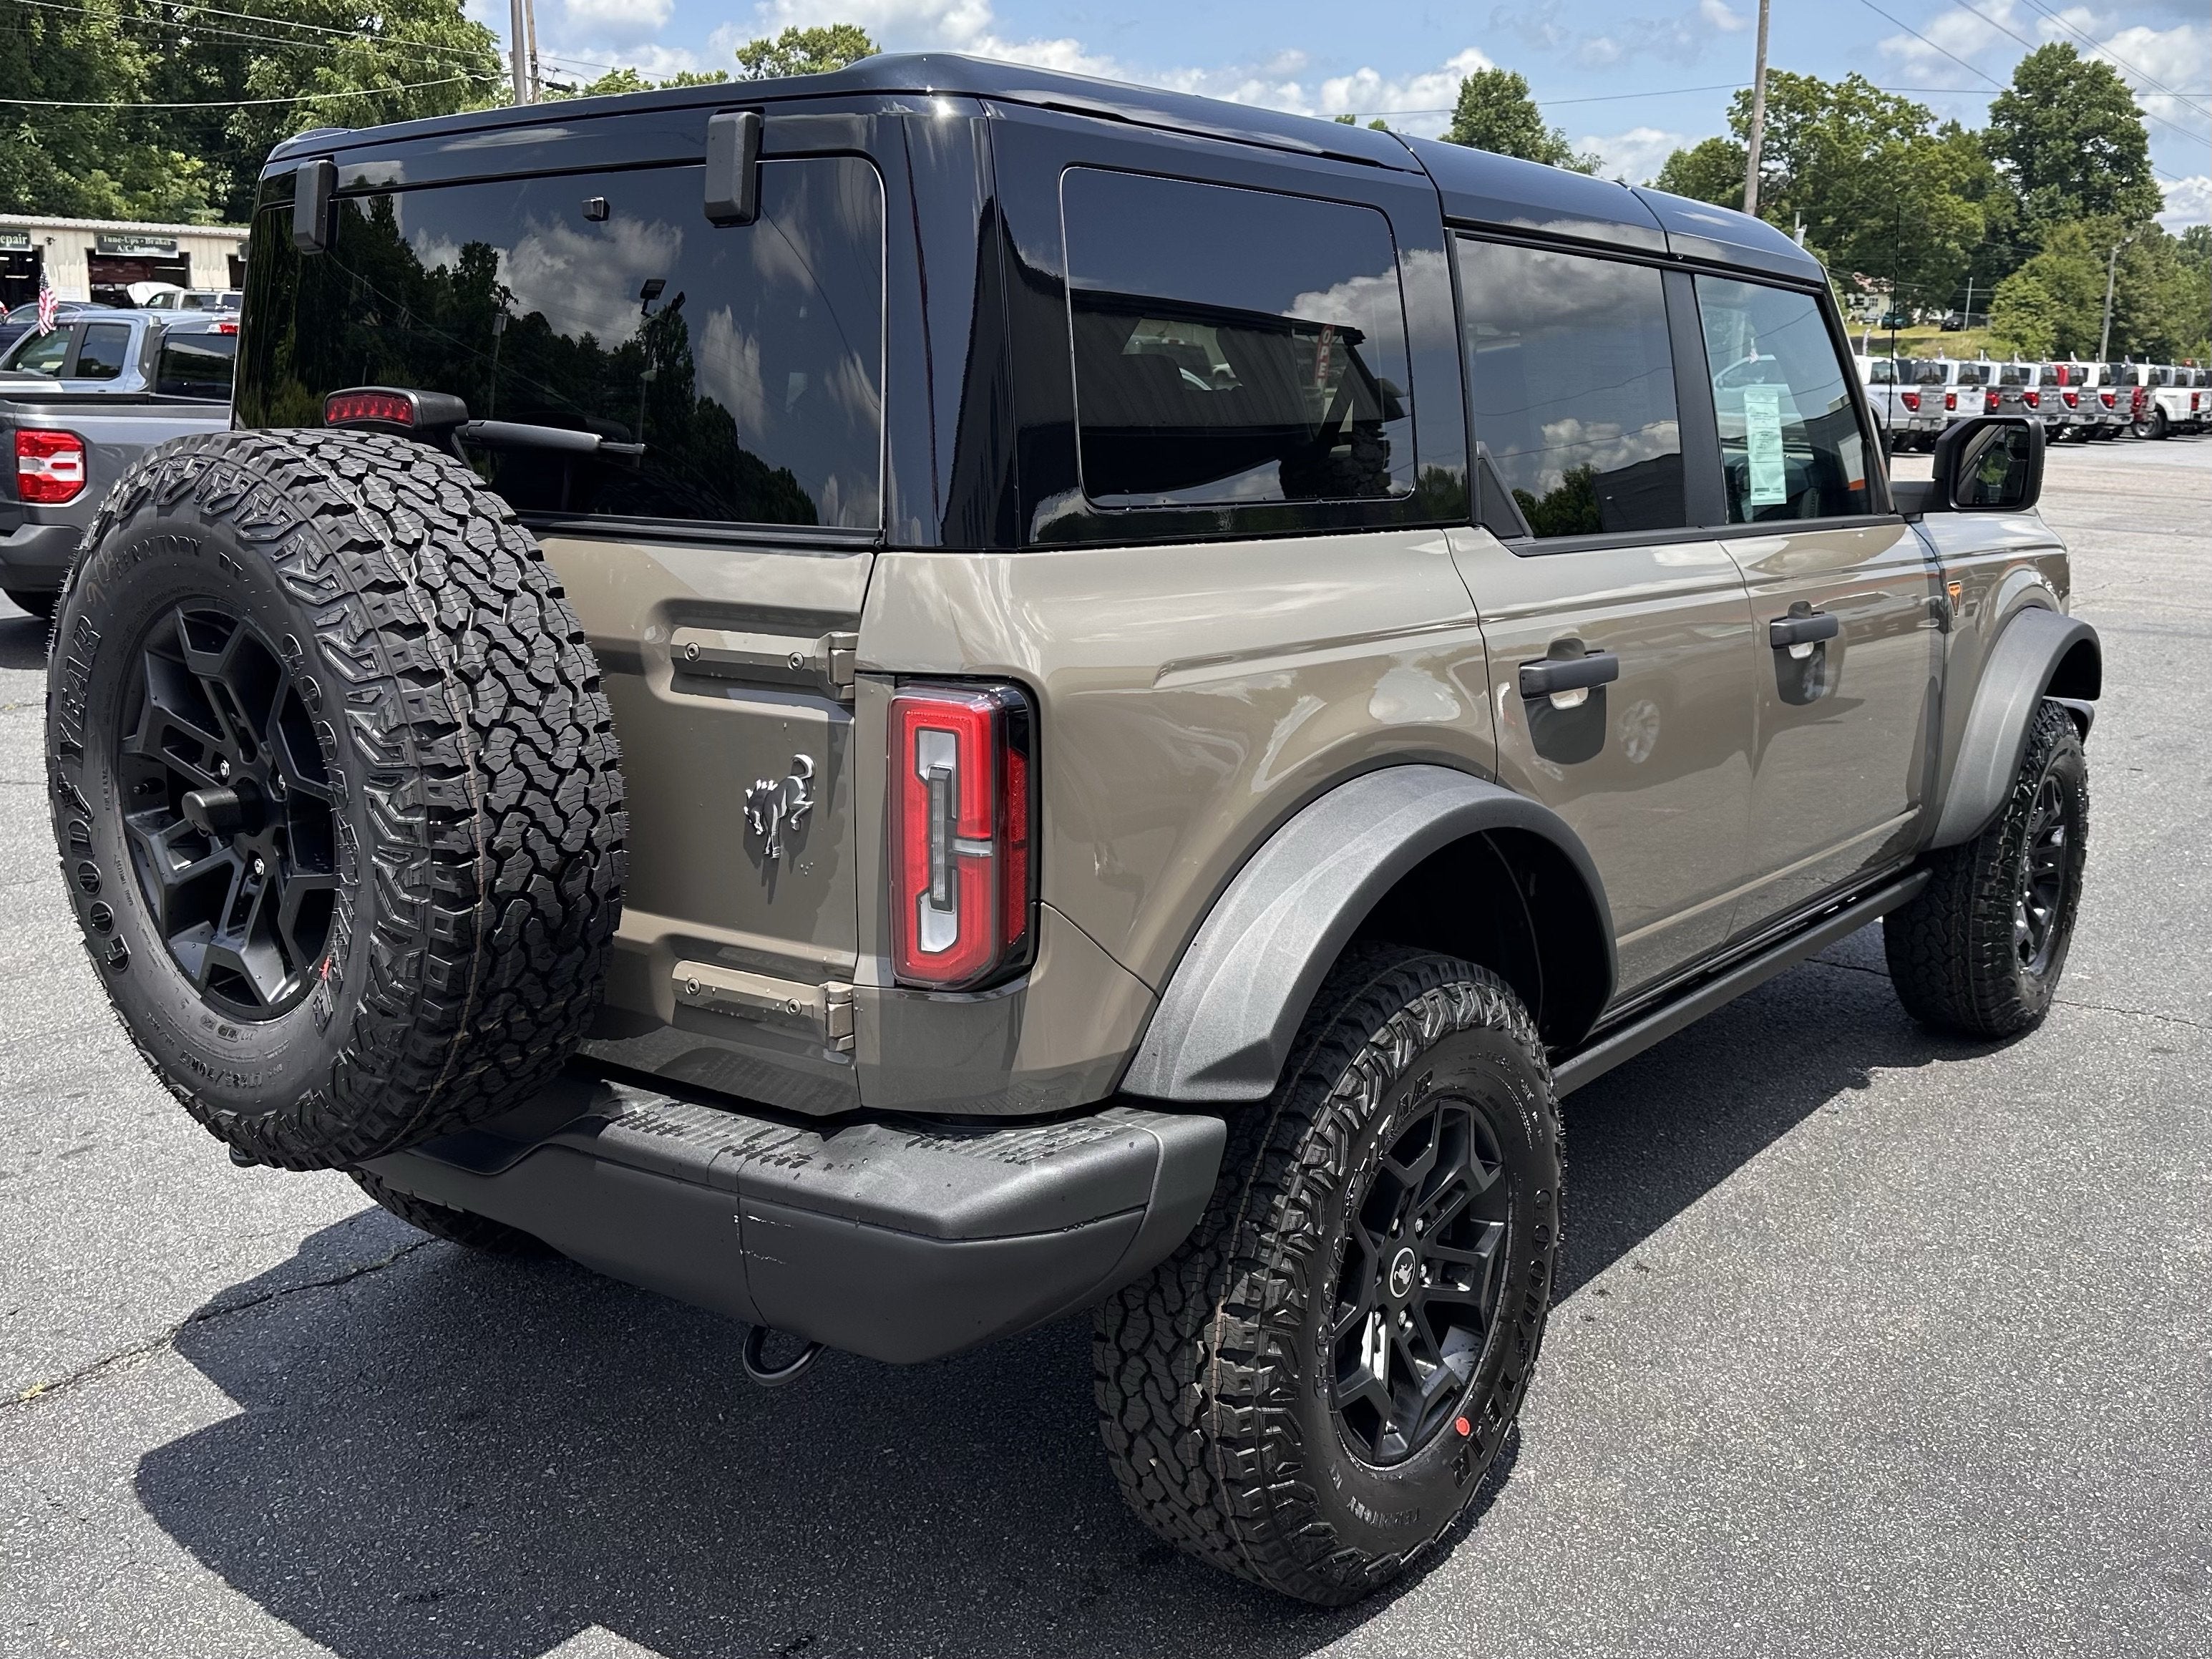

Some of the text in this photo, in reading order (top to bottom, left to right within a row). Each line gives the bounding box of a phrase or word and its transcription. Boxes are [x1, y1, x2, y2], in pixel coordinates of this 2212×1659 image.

[0, 233, 28, 247] epair
[103, 235, 171, 245] Tune-Ups Brakes
[115, 534, 203, 580] TERRITORY
[218, 551, 243, 580] RT
[57, 615, 132, 971] GOODYEAR
[179, 1049, 263, 1089] LT285/70R17
[1451, 1189, 1551, 1489] GOODYEAR
